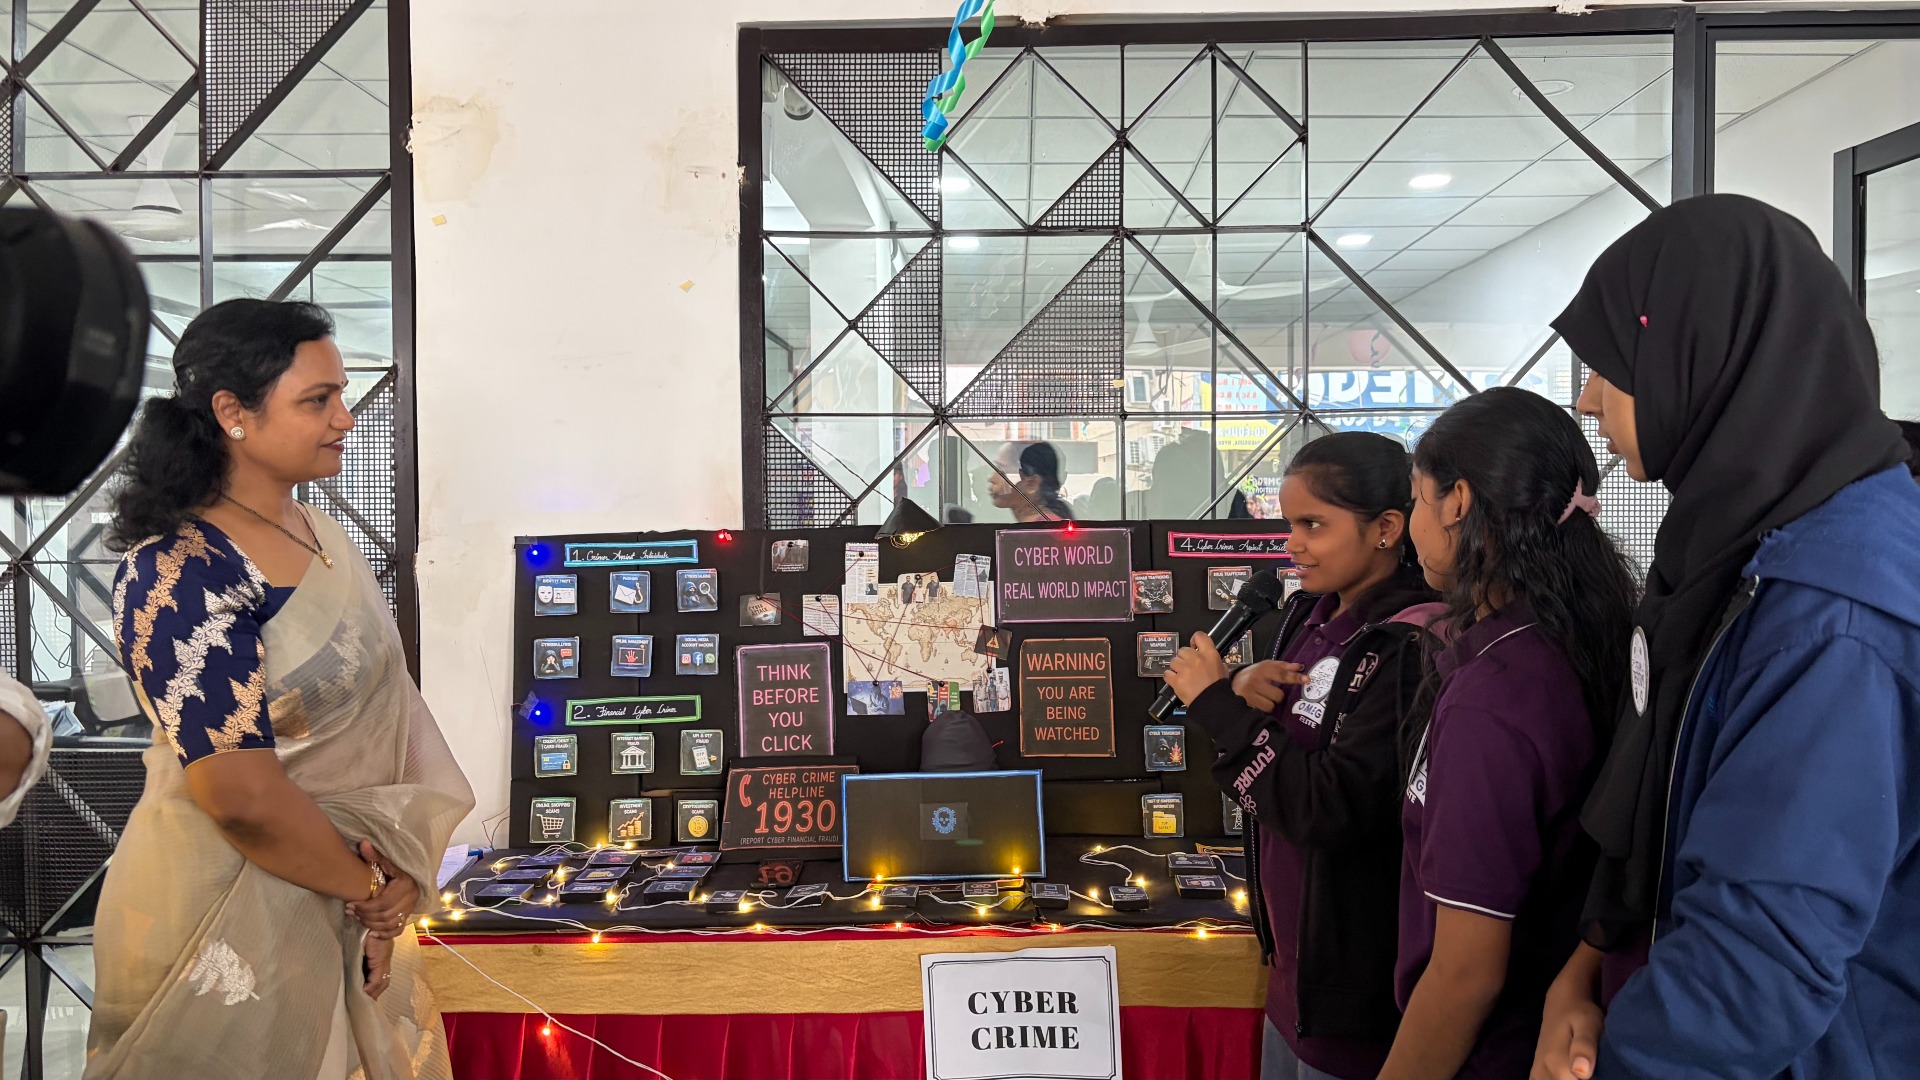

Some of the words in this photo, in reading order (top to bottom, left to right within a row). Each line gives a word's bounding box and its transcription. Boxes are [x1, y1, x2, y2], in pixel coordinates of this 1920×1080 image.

[1014, 547, 1059, 567] CYBER
[1064, 546, 1113, 566] WORLD
[1004, 582, 1034, 600] REAL
[1038, 581, 1080, 599] WORLD
[1084, 580, 1127, 598] IMPACT
[1026, 653, 1106, 671] WARNING
[756, 664, 811, 682] THINK
[753, 687, 819, 706] BEFORE
[1037, 686, 1064, 700] YOU
[1069, 686, 1095, 700] ARE
[573, 705, 591, 719] 2.
[1046, 706, 1087, 720] BEING
[1297, 701, 1323, 719] OMEG
[769, 711, 803, 728] YOU
[1034, 727, 1100, 741] WATCHED
[761, 735, 812, 752] CLICK
[762, 772, 796, 785] CYBER
[802, 771, 836, 784] CRIME
[1232, 745, 1276, 796] FUTURE
[769, 786, 825, 799] HELPLINE
[754, 799, 836, 833] 1930
[740, 836, 765, 846] (REPORT
[767, 836, 785, 844] CYBER
[787, 835, 817, 843] FINANCIAL
[818, 835, 839, 843] FRAUD)
[967, 990, 1079, 1014] CYBER
[971, 1025, 1080, 1051] CRIME
